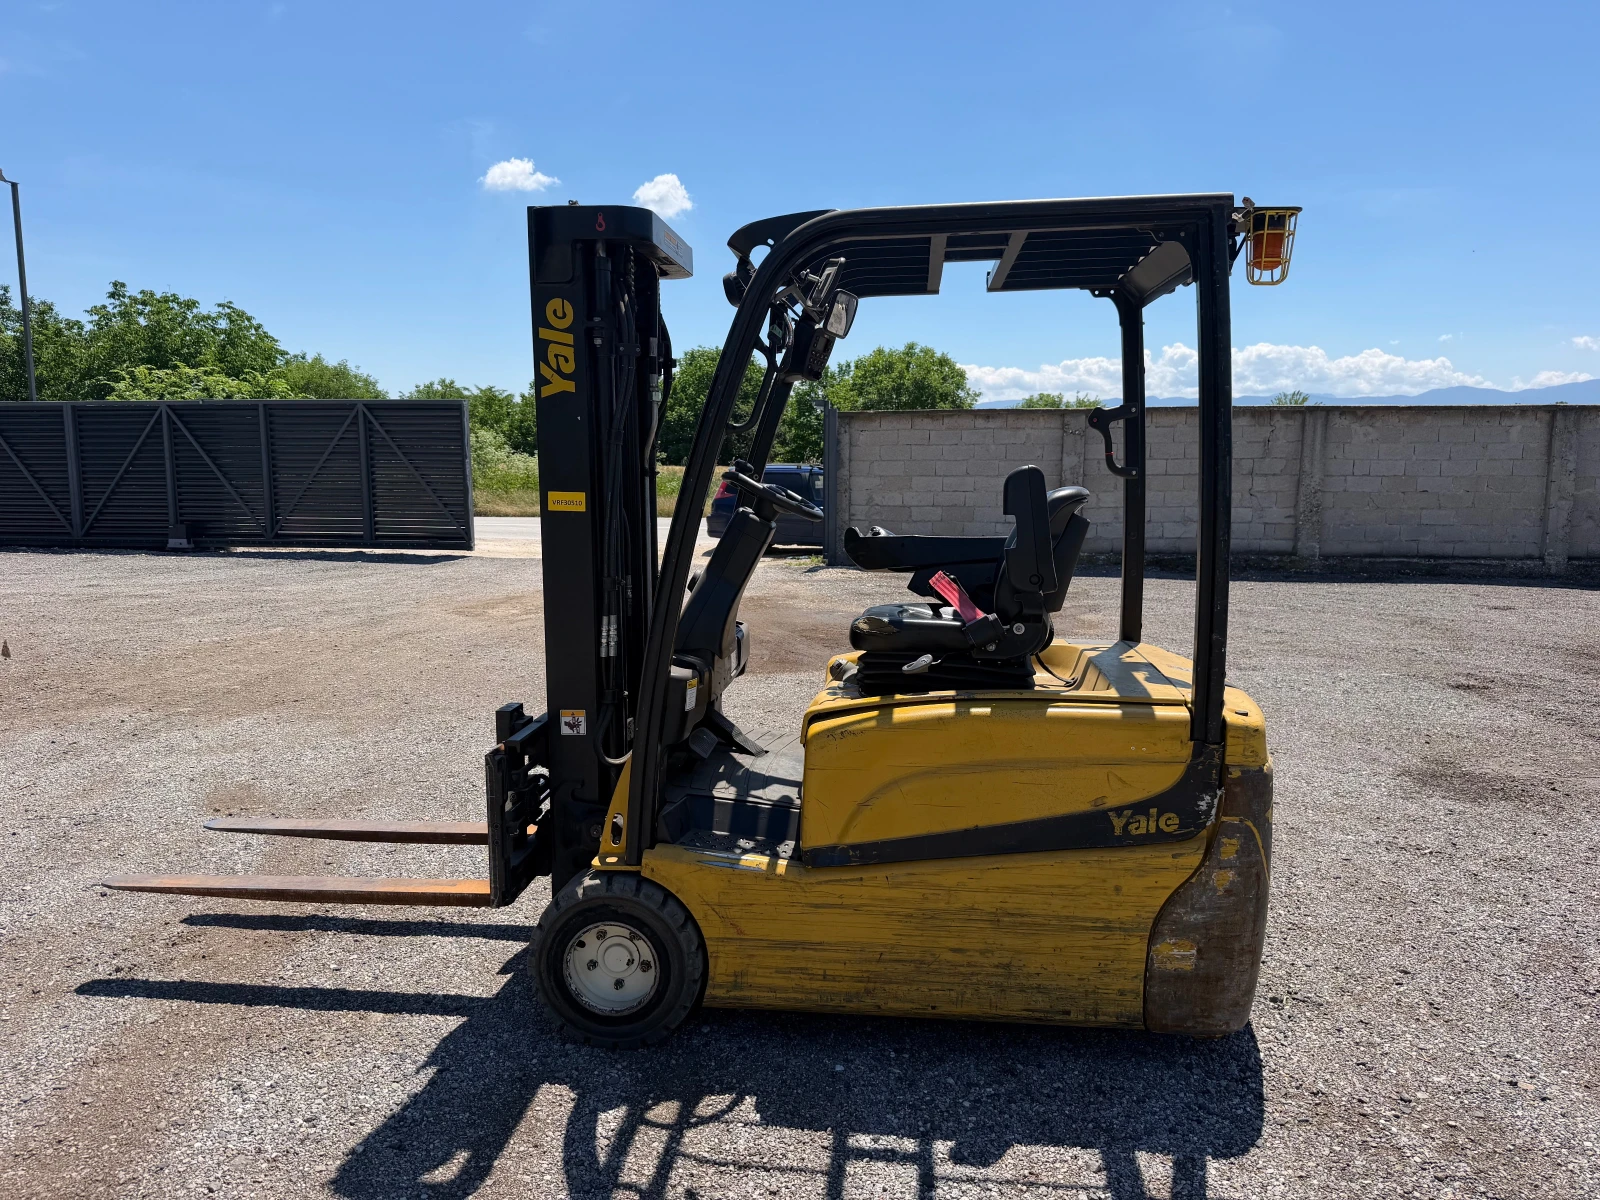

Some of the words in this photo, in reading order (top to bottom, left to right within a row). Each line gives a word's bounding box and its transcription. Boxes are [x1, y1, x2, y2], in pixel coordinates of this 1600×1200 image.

[538, 297, 576, 398] Yale
[552, 499, 583, 507] VRF30510
[1107, 808, 1180, 836] Yale
